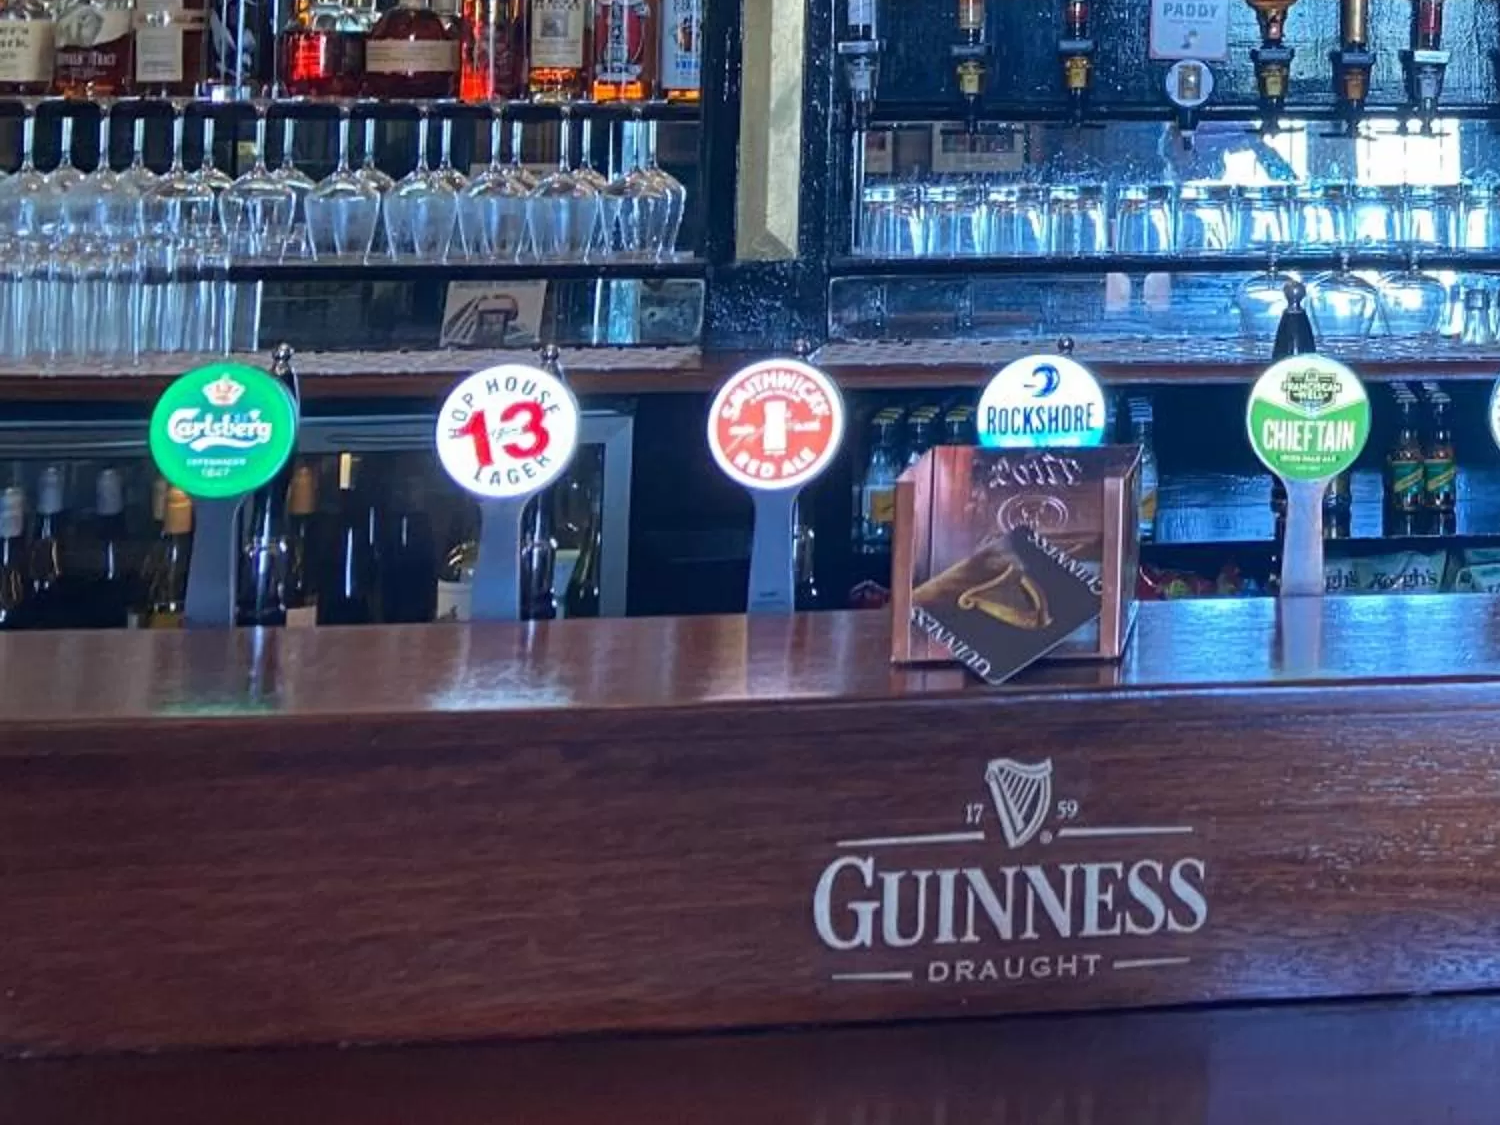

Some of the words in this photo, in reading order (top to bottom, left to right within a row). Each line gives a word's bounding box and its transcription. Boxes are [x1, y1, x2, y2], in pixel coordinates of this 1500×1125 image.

[1162, 2, 1220, 18] PADDY
[448, 392, 475, 440] HOP
[486, 376, 562, 417] HOUSE
[986, 402, 1096, 437] ROCKSHORE
[167, 408, 273, 447] Carlsberg
[457, 400, 550, 468] 13
[1262, 418, 1357, 452] CHIEFTAIN
[473, 454, 552, 487] LAGER
[965, 803, 984, 825] 17
[1056, 799, 1079, 821] 59
[812, 854, 1209, 950] GUINNESS
[927, 953, 1103, 984] DRAUGHT
